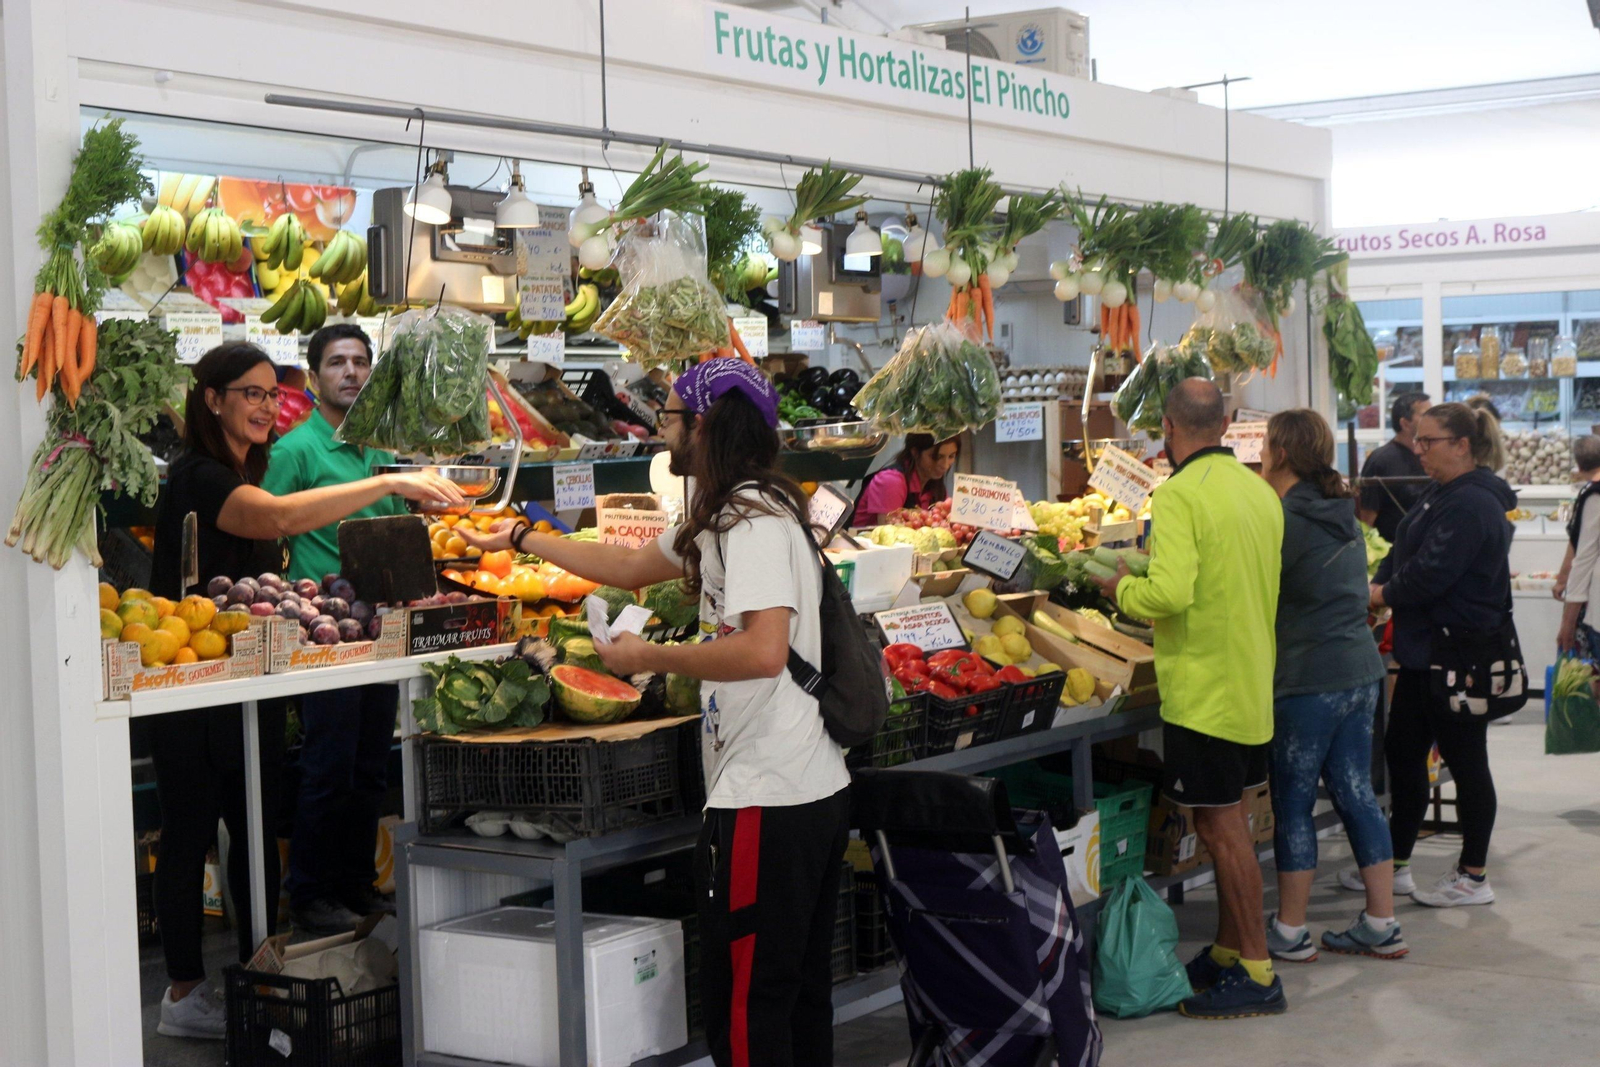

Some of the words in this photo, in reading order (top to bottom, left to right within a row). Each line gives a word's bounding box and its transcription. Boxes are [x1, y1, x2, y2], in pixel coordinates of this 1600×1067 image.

[714, 11, 808, 70] Frutas
[815, 43, 830, 86] y
[838, 36, 966, 99] Hortalizas
[971, 64, 991, 104] El
[997, 70, 1070, 119] Pincho
[1338, 234, 1391, 252] rutos
[1398, 229, 1458, 249] Secos
[1466, 225, 1486, 244] A.
[1494, 223, 1546, 242] Rosa
[531, 284, 562, 295] PATATAS
[1009, 410, 1040, 419] HUEVOS
[971, 487, 1011, 503] CHIRIMOYAS
[618, 525, 664, 540] CAQUIS
[881, 610, 909, 619] FRUTERIA
[899, 611, 942, 623] PIMIENTOS
[903, 622, 924, 630] ASAR
[925, 617, 951, 627] ROJOS
[413, 632, 459, 649] TRAYMAR
[460, 627, 492, 642] FRUITS
[290, 646, 337, 666] Exotic
[340, 644, 373, 660] GOURMET
[132, 668, 186, 691] Exotic
[188, 661, 226, 682] GOURMET
